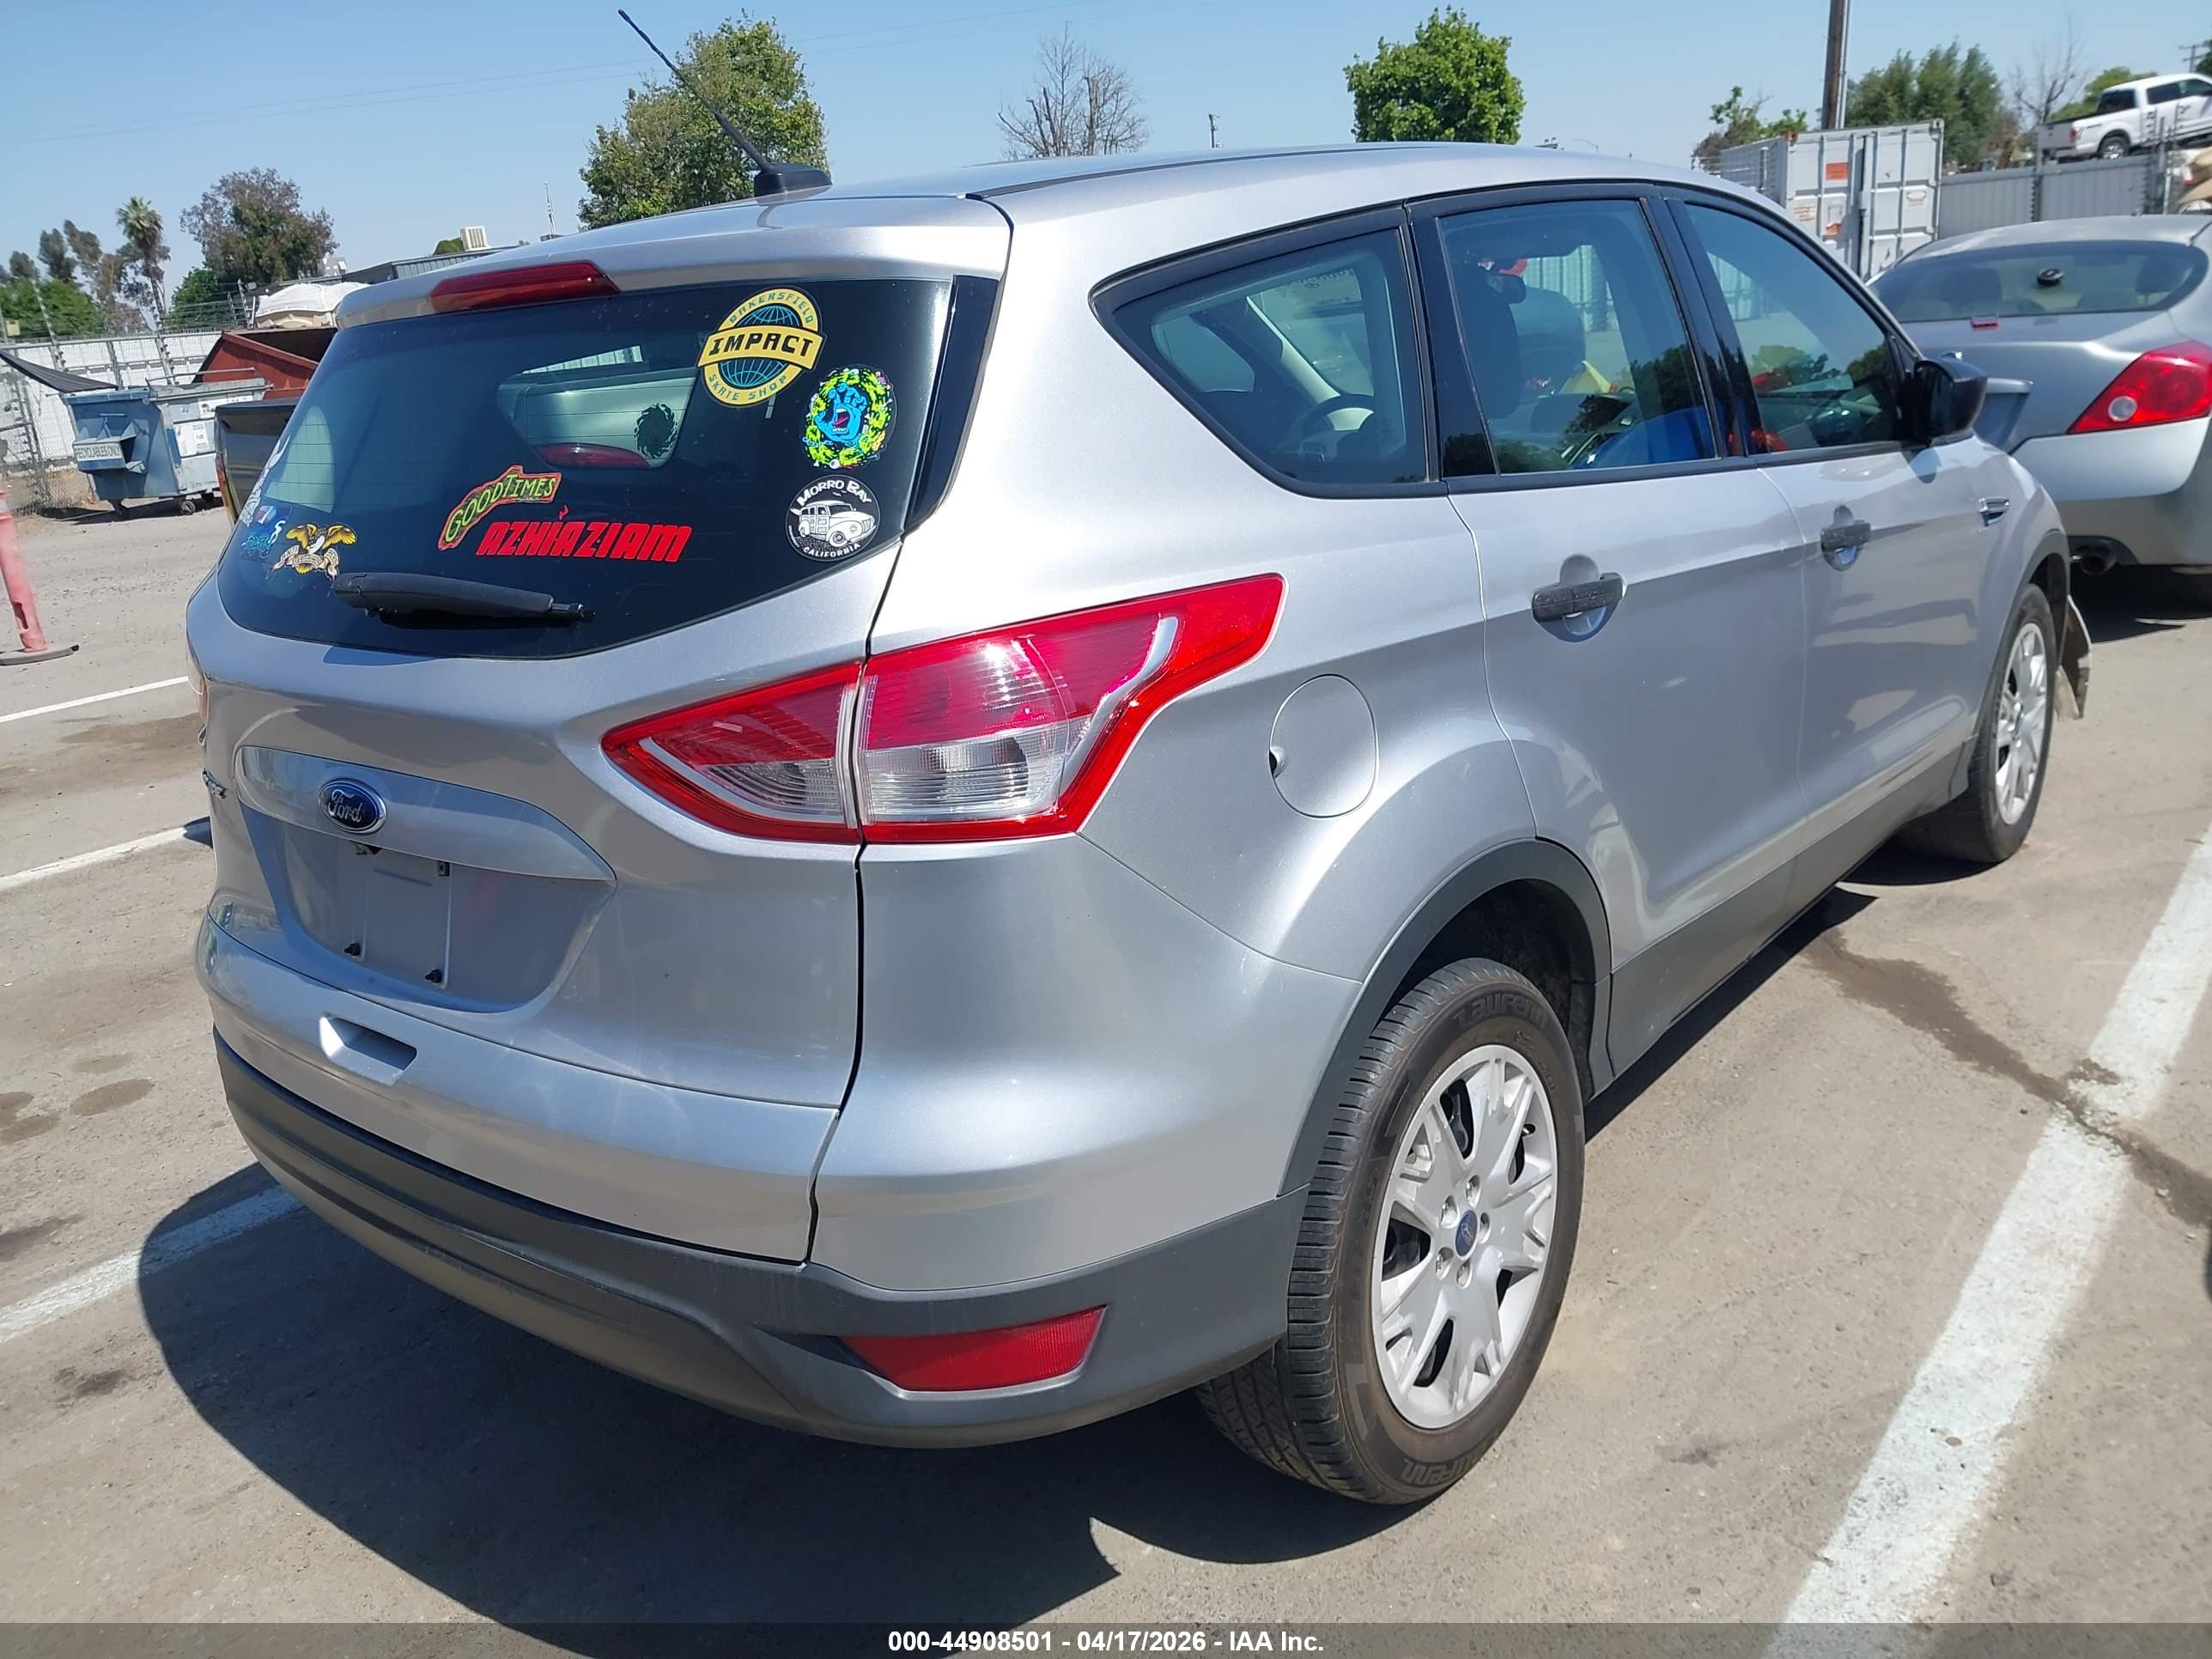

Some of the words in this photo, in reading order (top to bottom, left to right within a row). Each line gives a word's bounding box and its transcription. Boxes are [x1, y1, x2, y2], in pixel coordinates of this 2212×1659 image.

[730, 292, 814, 324] BAKERSFIELD
[708, 332, 813, 357] IMPACT
[708, 374, 740, 400] SKATE
[748, 374, 787, 400] SHOP
[796, 480, 844, 506] MORRO
[847, 480, 872, 503] BAY
[804, 543, 860, 558] CALIFORNIA
[328, 788, 363, 823] Ford
